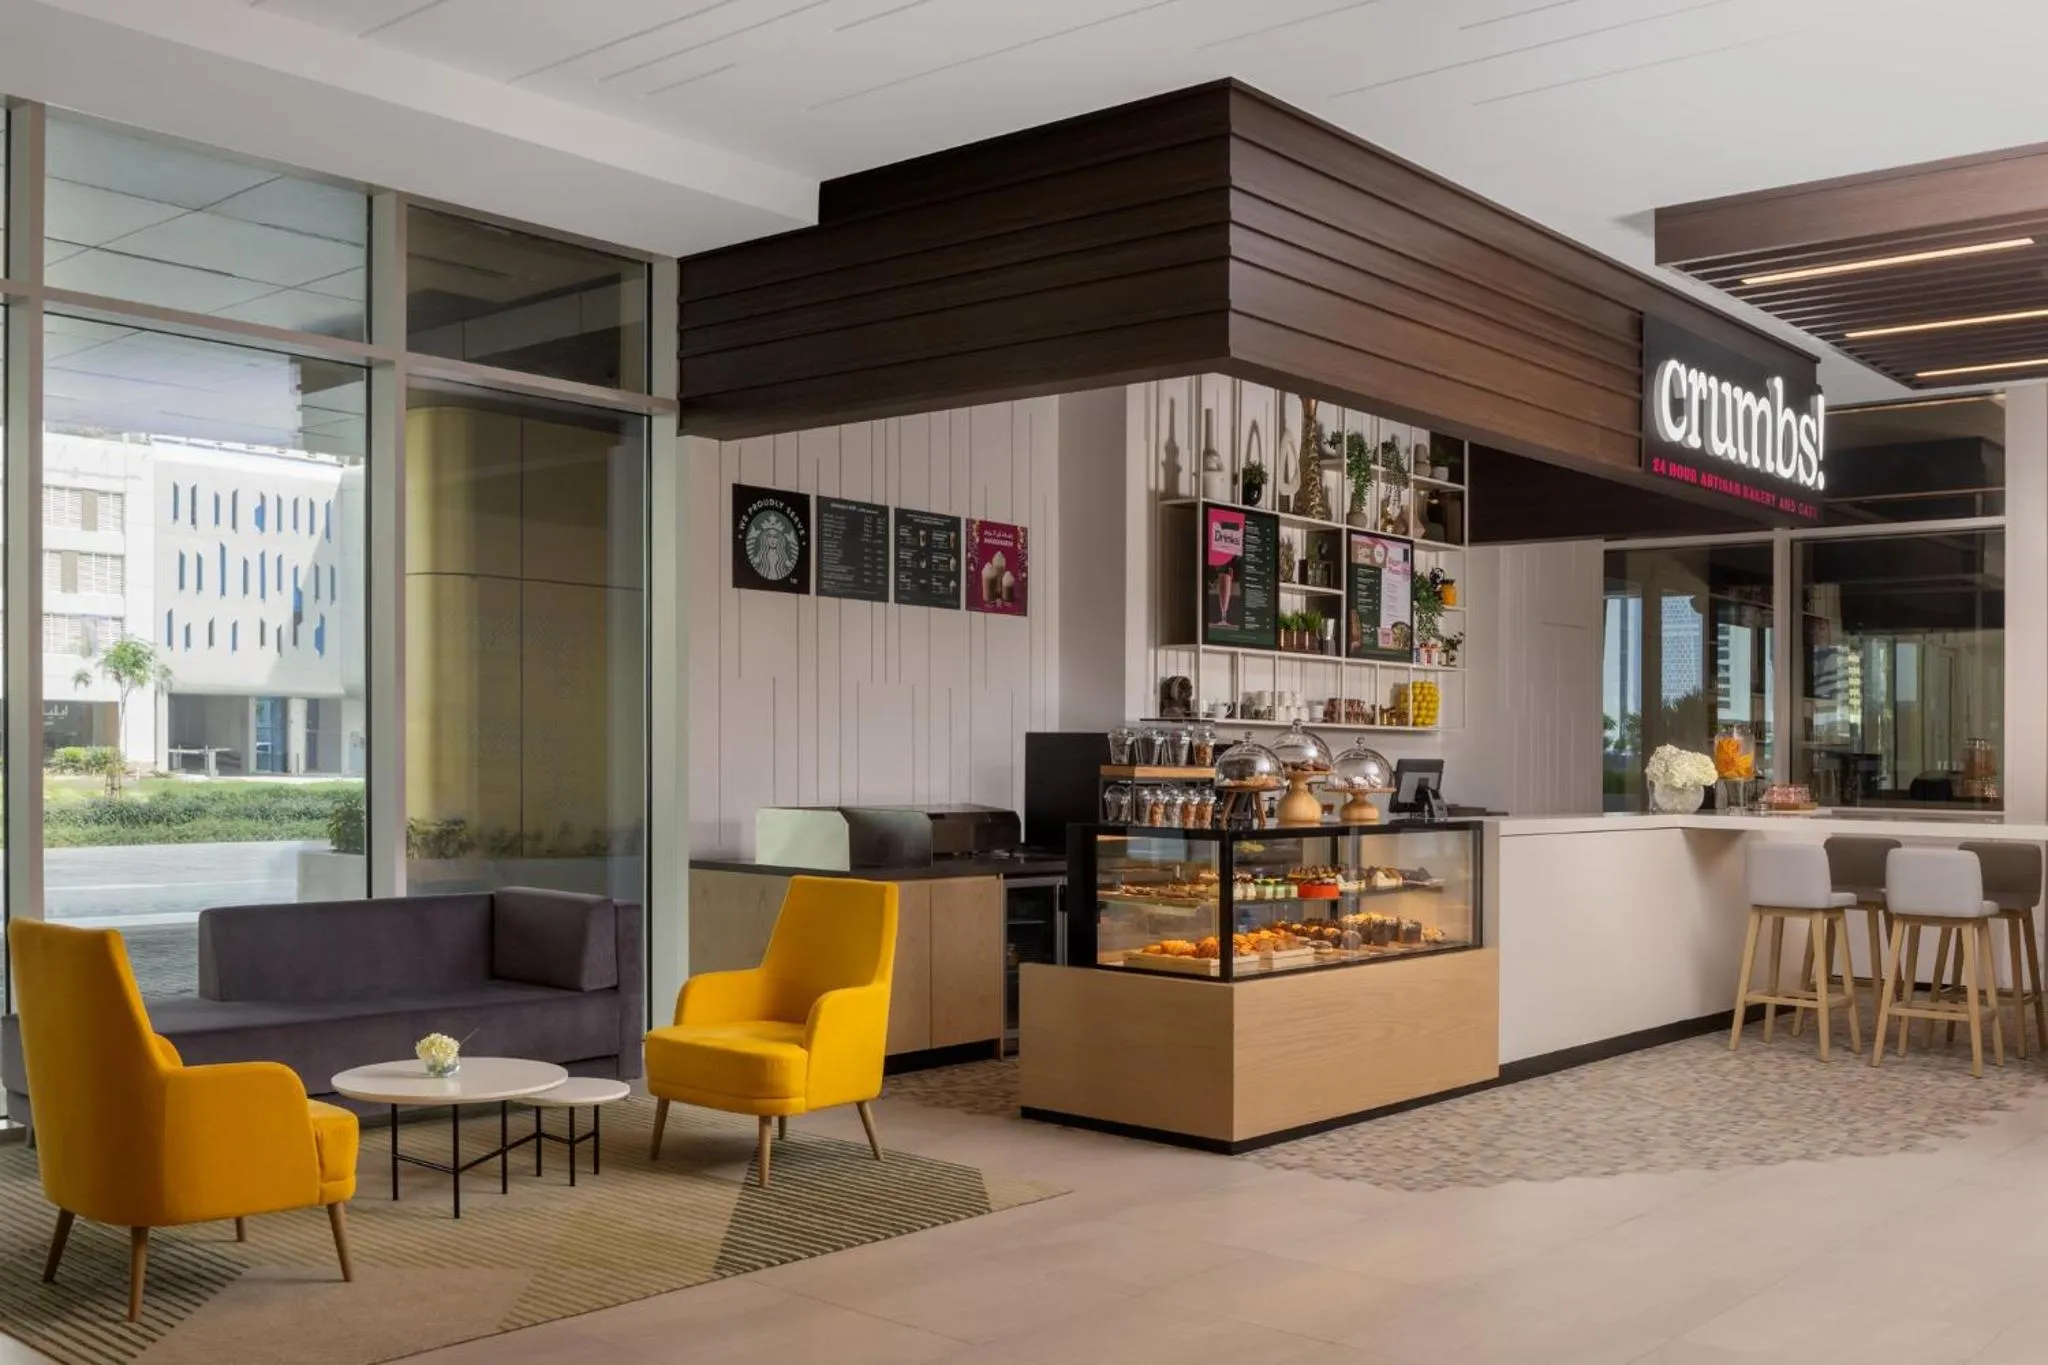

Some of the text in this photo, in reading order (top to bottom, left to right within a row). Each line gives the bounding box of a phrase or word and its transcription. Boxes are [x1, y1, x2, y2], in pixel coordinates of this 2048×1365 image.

[1653, 359, 1825, 490] crumbs!
[748, 498, 785, 514] PROUDLY
[1652, 457, 1666, 475] 24
[1669, 462, 1697, 484] HOUR
[1701, 471, 1741, 495] ARTISAN
[1742, 484, 1776, 508] BAKERY
[1779, 496, 1797, 512] AND
